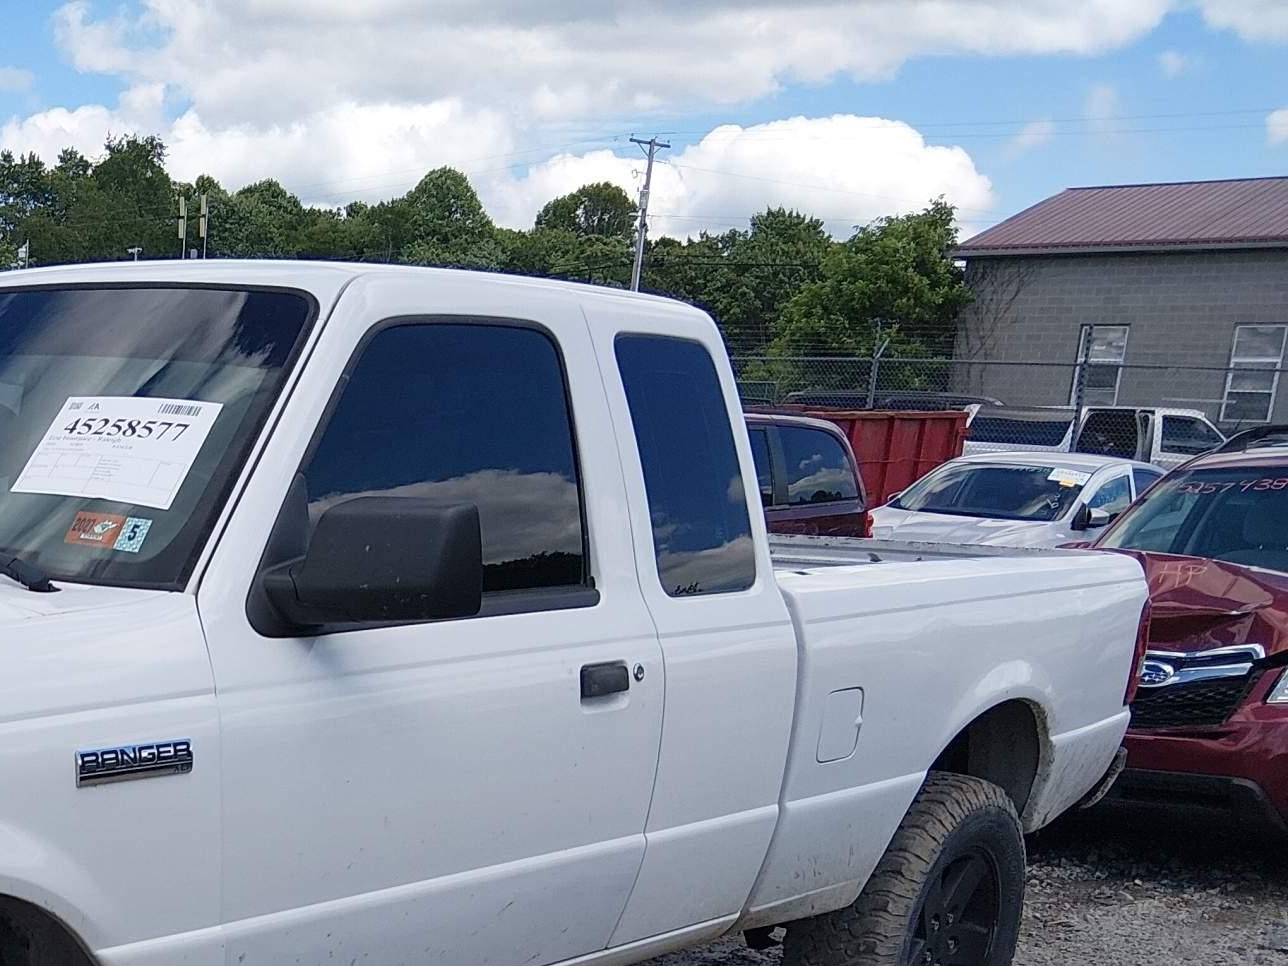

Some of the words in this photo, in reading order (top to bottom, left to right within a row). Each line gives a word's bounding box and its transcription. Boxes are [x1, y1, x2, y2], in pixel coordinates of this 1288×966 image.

[64, 417, 191, 441] 45258577
[127, 524, 141, 542] 5
[78, 740, 192, 775] RANGER
